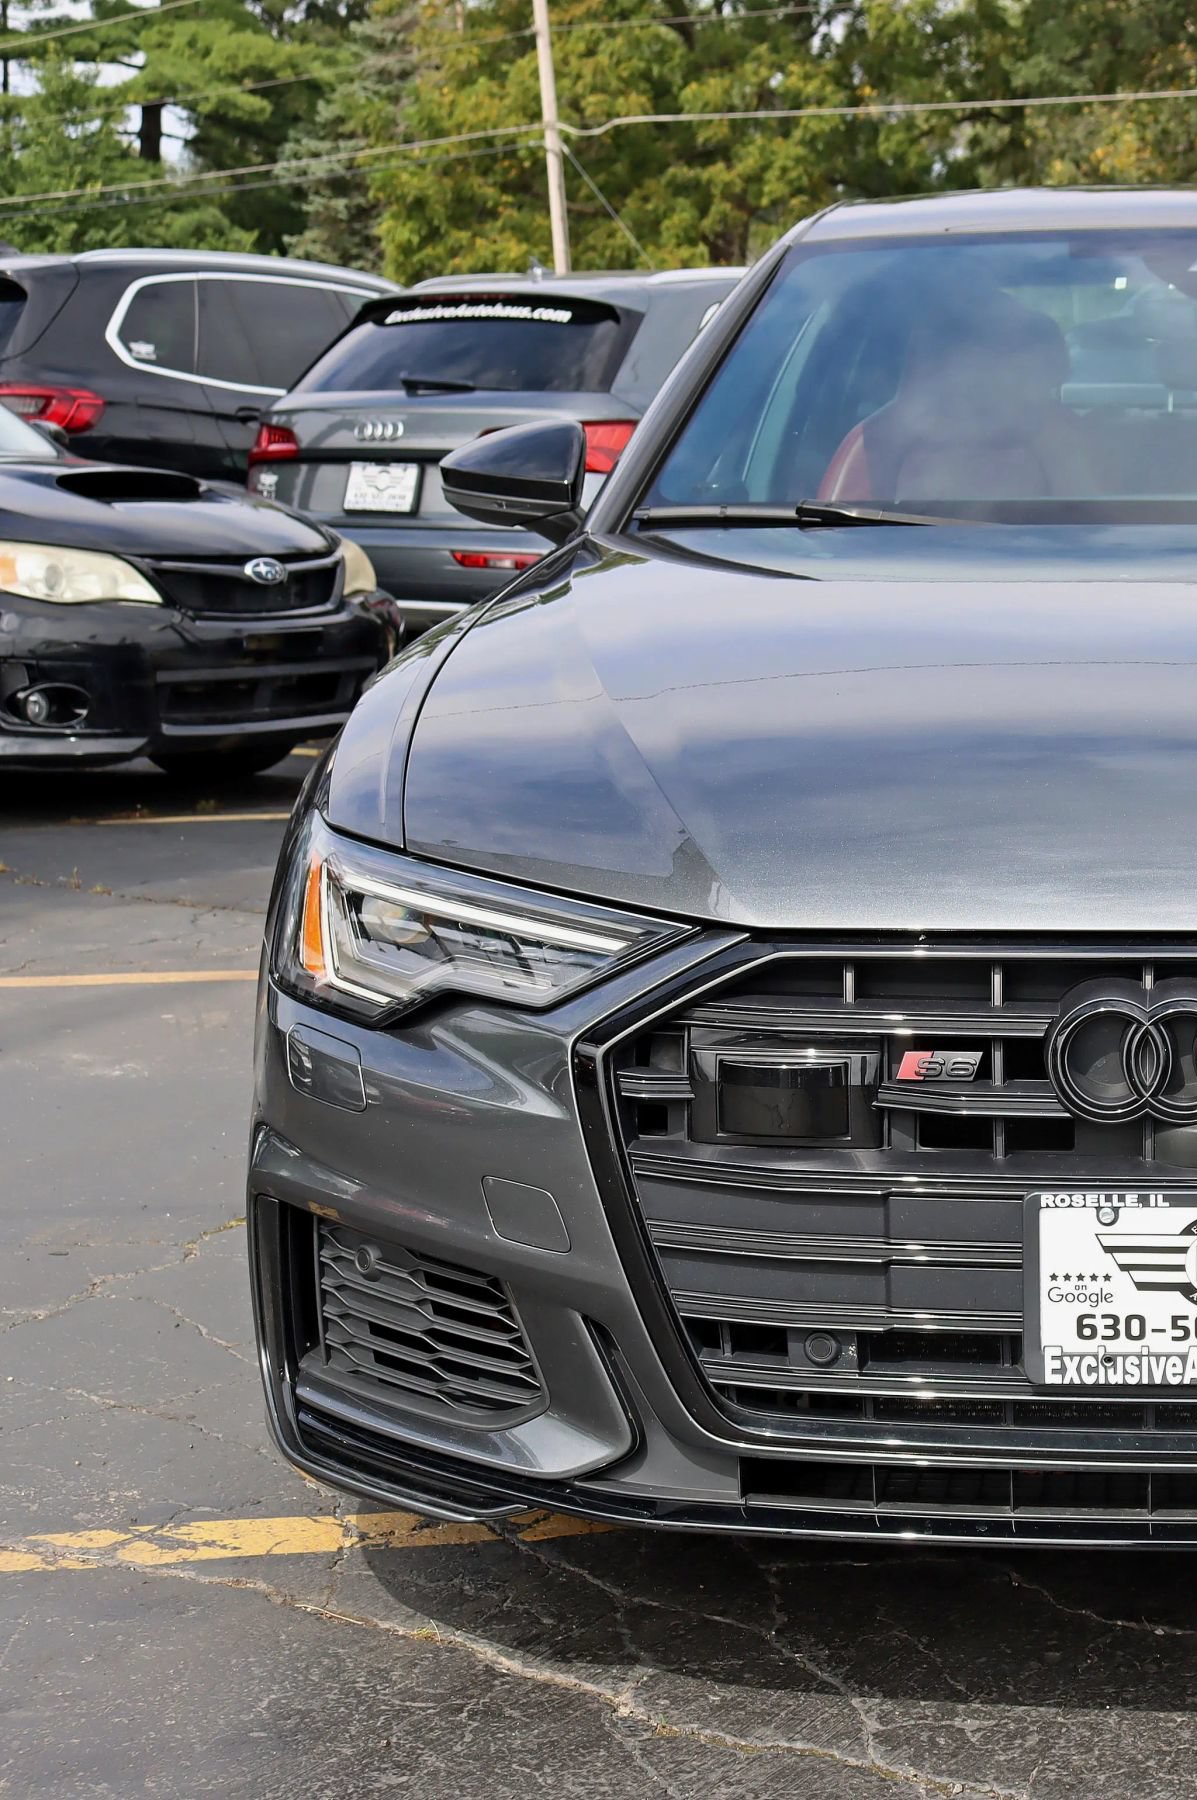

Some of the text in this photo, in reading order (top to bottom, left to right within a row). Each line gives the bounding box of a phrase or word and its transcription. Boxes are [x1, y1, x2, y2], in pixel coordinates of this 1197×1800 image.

[915, 1058, 977, 1077] S6
[1040, 1194, 1170, 1209] ROSELLE, IL
[1047, 1286, 1114, 1308] Google
